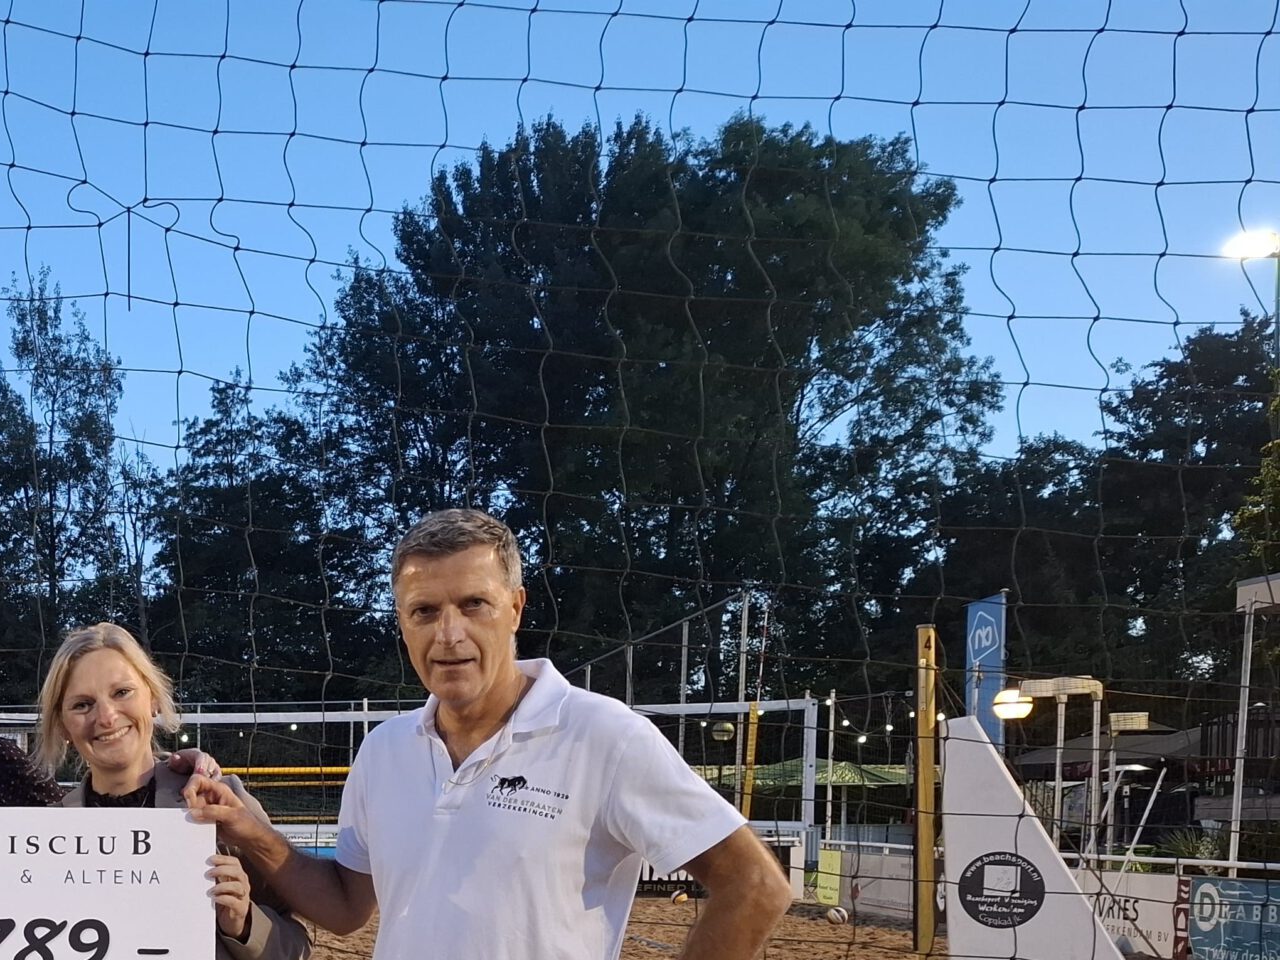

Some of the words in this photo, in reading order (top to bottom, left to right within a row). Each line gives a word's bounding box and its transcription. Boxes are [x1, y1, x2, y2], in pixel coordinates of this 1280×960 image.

[923, 635, 932, 651] 4
[530, 786, 551, 796] ANNO
[486, 793, 501, 801] VAN
[502, 795, 519, 805] DER
[520, 799, 563, 815] STRAATEN
[488, 801, 556, 820] VERZEKERINGEN
[964, 853, 1042, 881] www.beachsport.nl
[20, 869, 32, 884] &
[64, 869, 161, 885] ALTENA
[1158, 931, 1169, 942] BV
